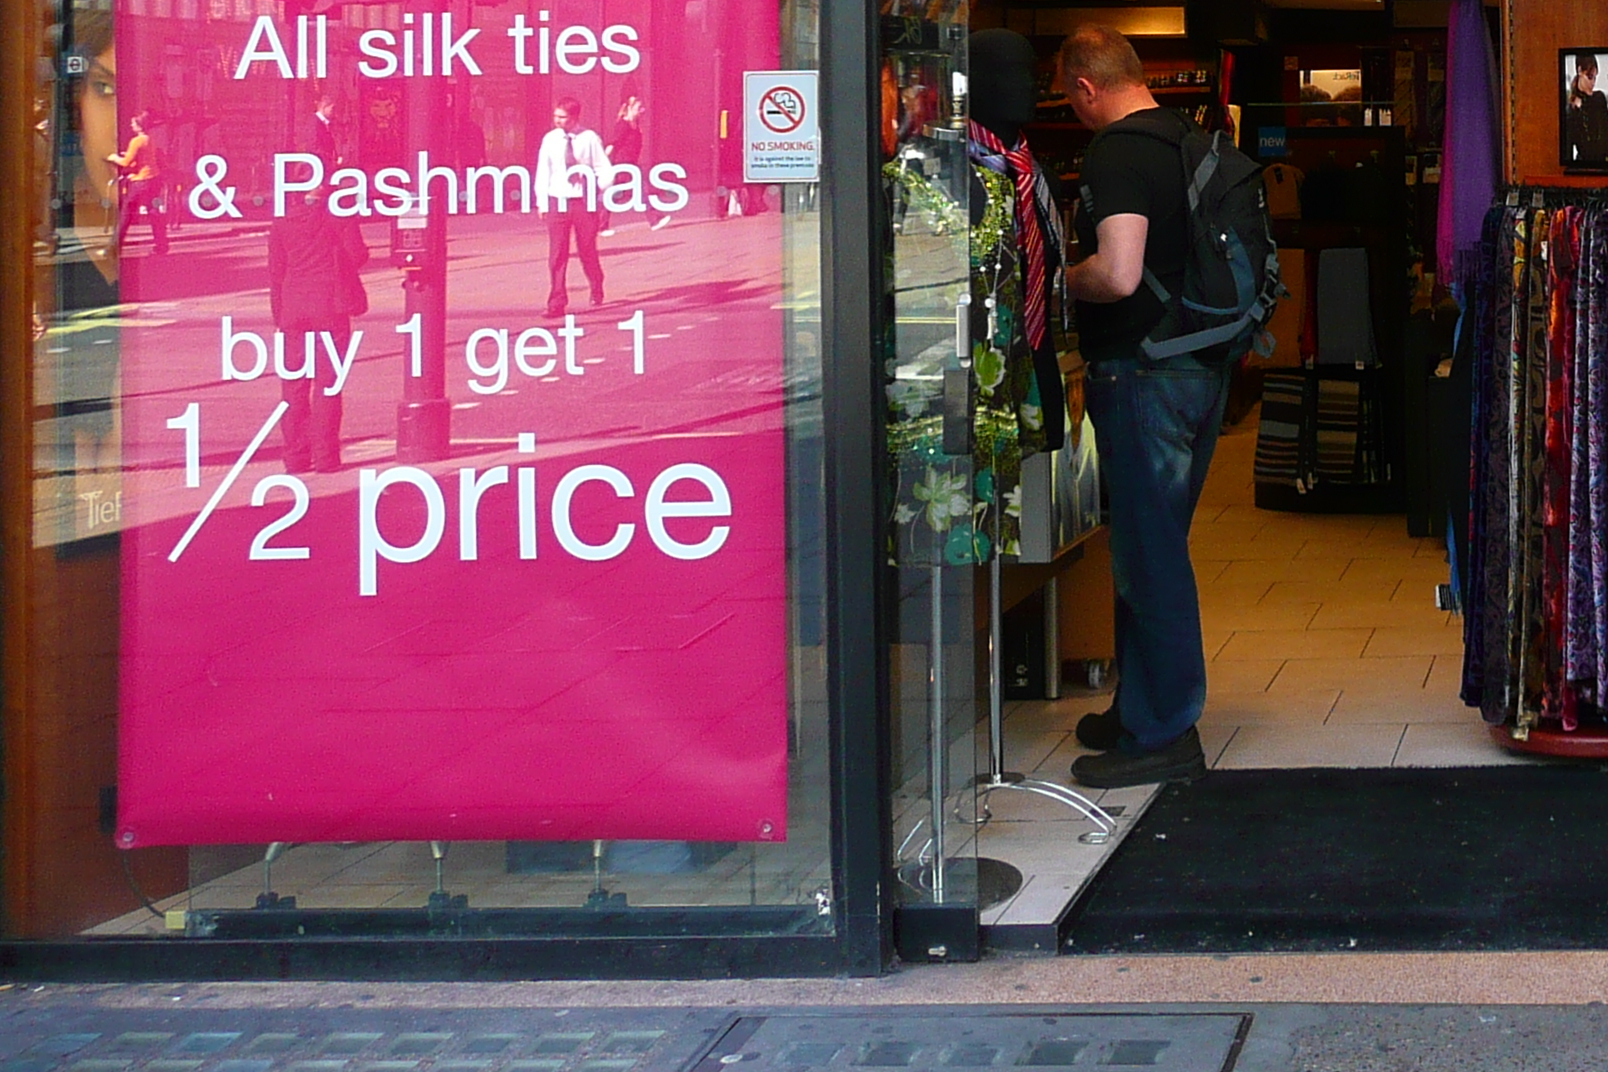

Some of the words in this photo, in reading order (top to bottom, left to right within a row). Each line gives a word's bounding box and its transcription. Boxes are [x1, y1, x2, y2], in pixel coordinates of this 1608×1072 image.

[233, 14, 327, 80] All
[358, 12, 483, 79] silk
[507, 10, 641, 76] ties
[751, 141, 766, 151] NO
[1259, 135, 1286, 148] new
[188, 154, 243, 219] &
[273, 149, 689, 219] Pashminas
[221, 314, 364, 397] buy
[395, 312, 423, 378] 1
[465, 313, 587, 395] get
[616, 309, 645, 375] 1
[358, 432, 733, 597] price
